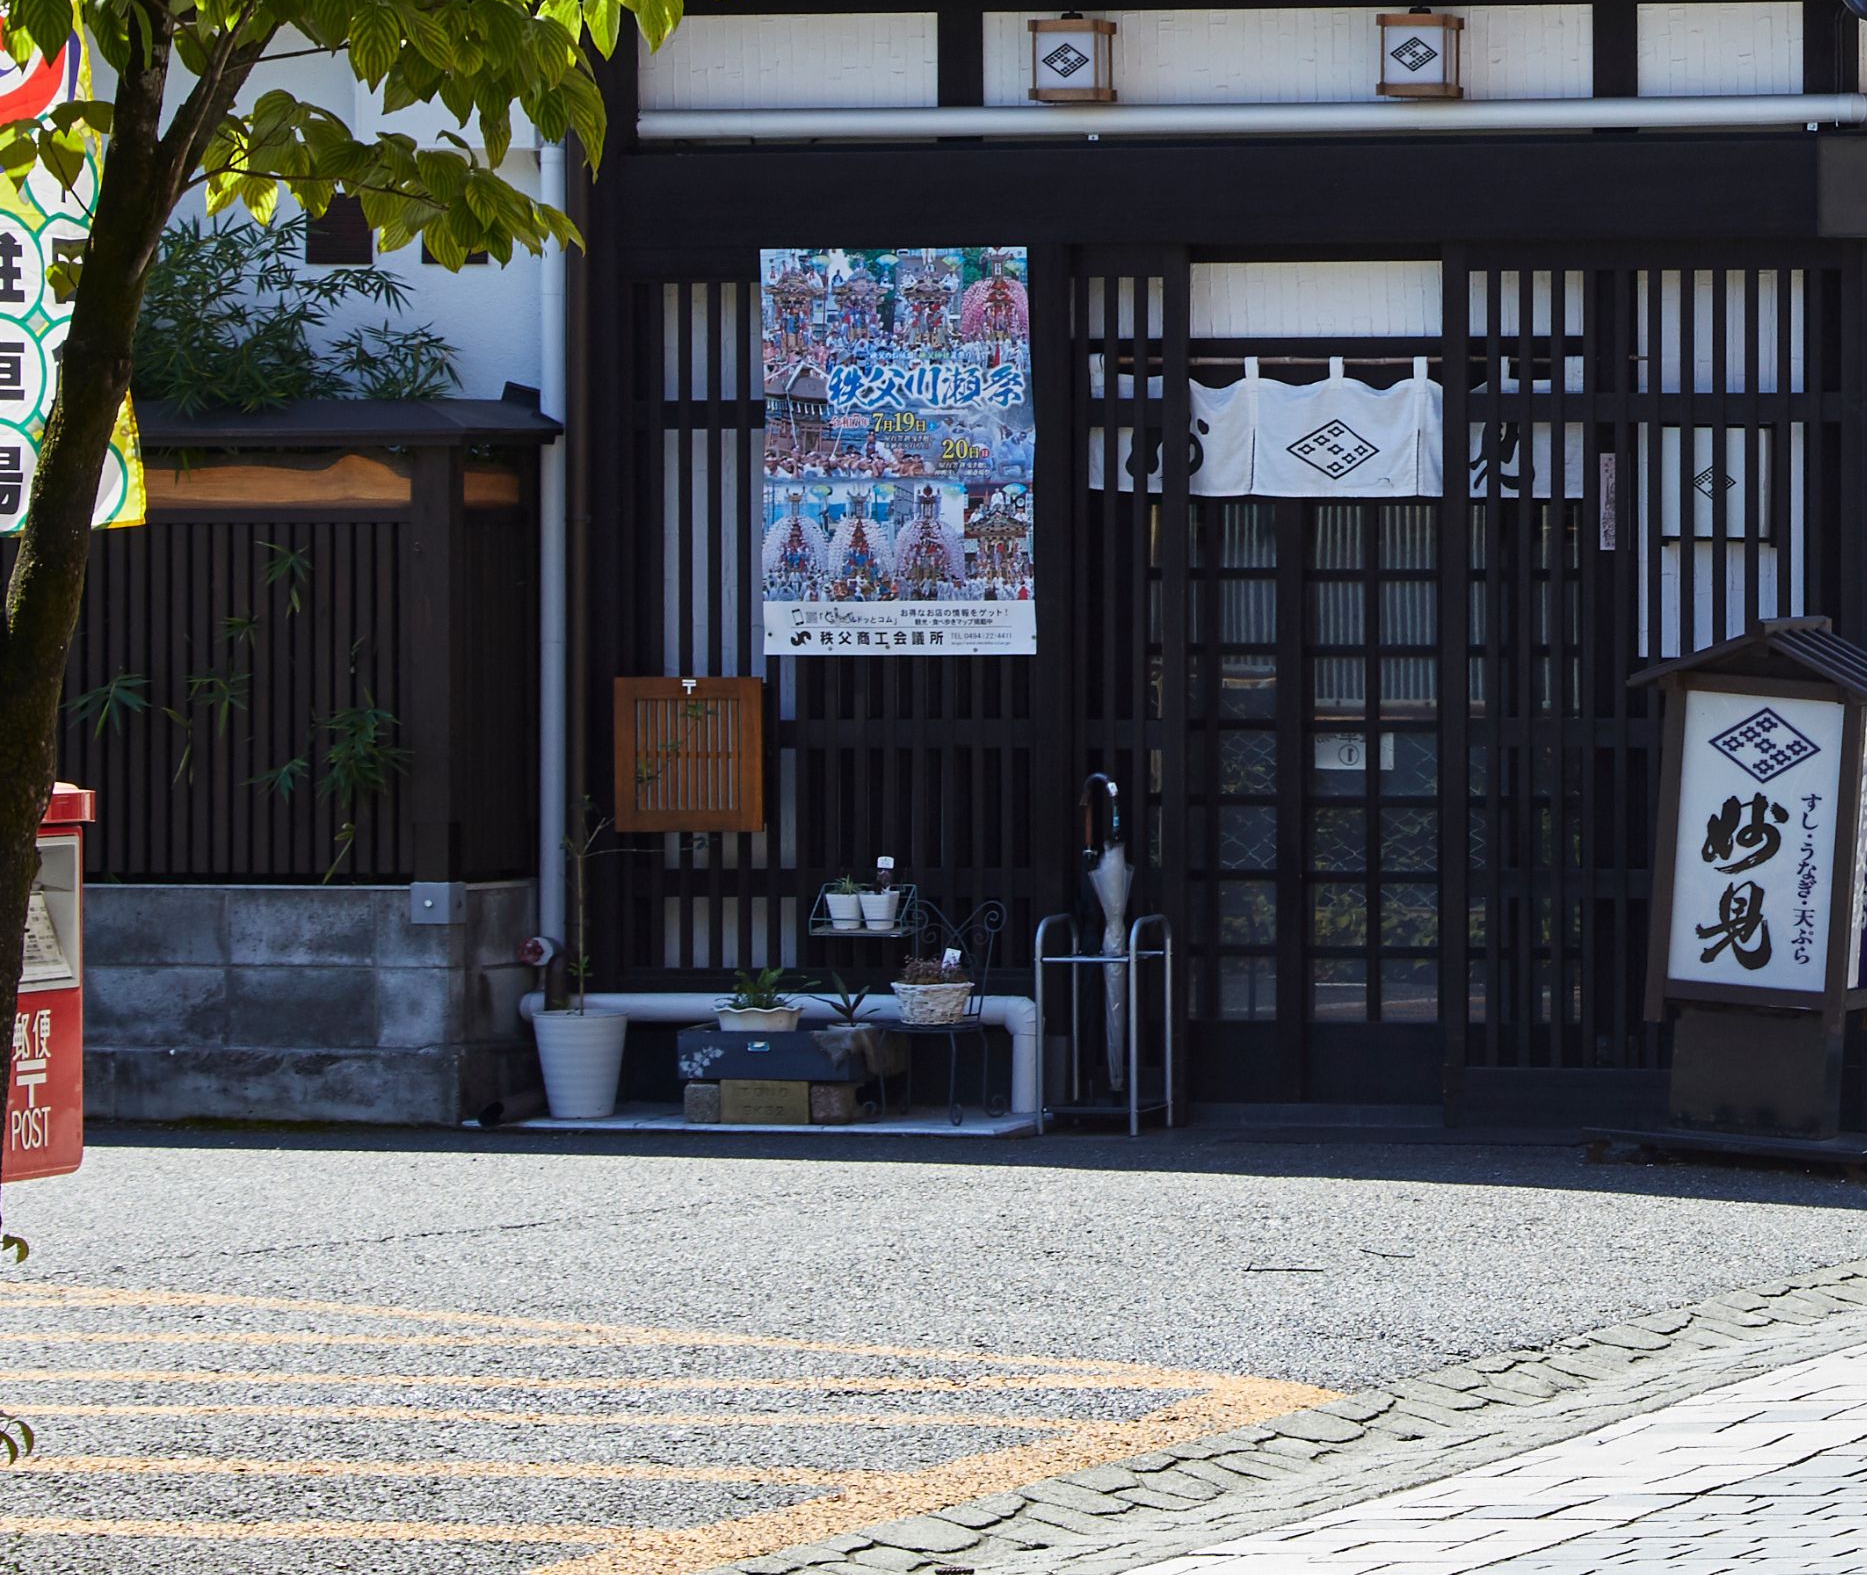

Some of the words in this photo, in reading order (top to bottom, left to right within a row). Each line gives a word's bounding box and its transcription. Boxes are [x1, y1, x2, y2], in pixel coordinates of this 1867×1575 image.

[828, 365, 1025, 408] 秩父川瀬祭
[873, 412, 926, 433] 7月19日
[942, 439, 980, 459] 20日
[820, 630, 944, 645] 秩父商工会議所
[1695, 792, 1790, 971] 妙見
[1792, 793, 1823, 965] すし・うなぎ・天ぷら
[11, 1106, 51, 1151] POST
